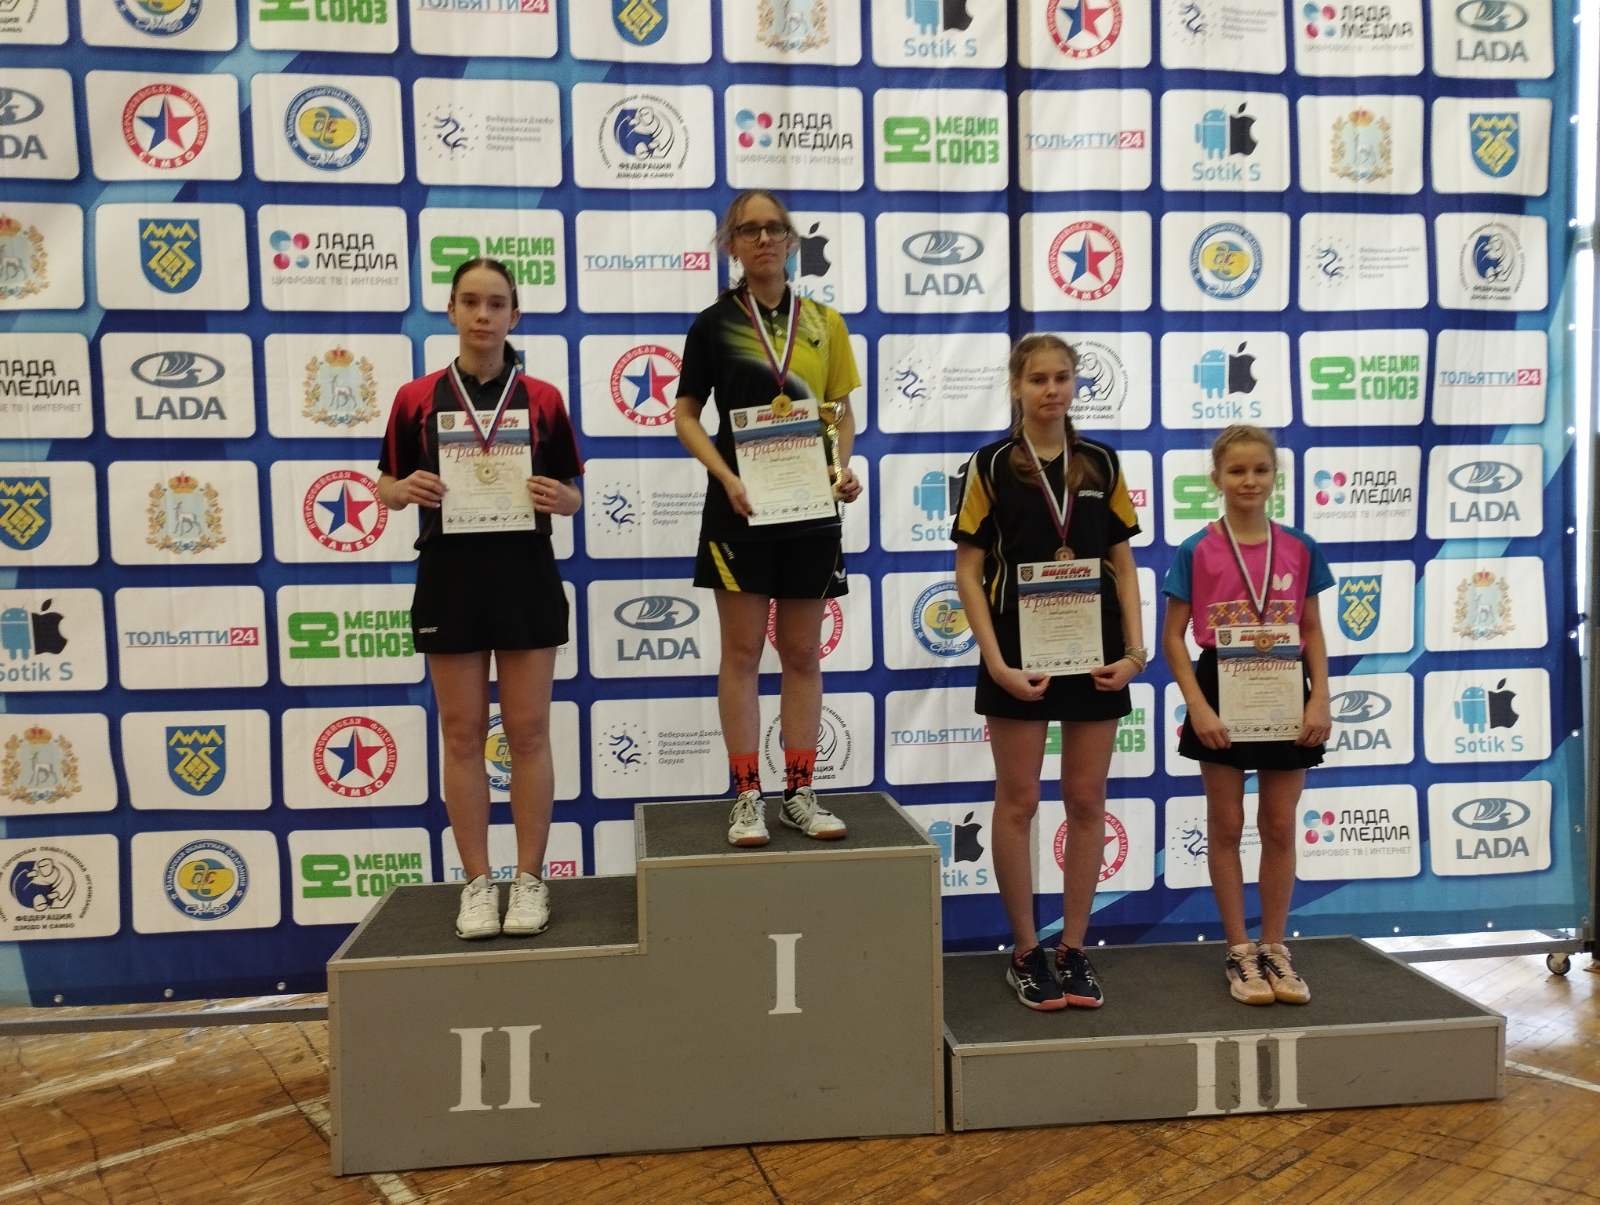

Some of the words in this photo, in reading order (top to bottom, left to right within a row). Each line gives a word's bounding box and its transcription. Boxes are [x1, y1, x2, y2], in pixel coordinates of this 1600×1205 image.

[315, 0, 388, 25] СОЮЗ
[1340, 5, 1391, 21] ЛАДА
[1340, 23, 1413, 40] МЕДИА
[904, 38, 957, 58] Sotik
[964, 38, 978, 58] S
[1456, 39, 1530, 63] LADA
[777, 112, 832, 130] ЛАДА
[935, 116, 999, 136] МЕДИА
[0, 135, 48, 161] DA
[777, 132, 853, 151] МЕДИА
[138, 149, 196, 169] САМБО
[935, 139, 999, 165] СОЮЗ
[1192, 162, 1242, 182] Sotik
[1249, 162, 1262, 182] S
[315, 232, 375, 251] ЛАДА
[486, 236, 555, 256] МЕДИА
[316, 253, 399, 272] МЕДИА
[504, 259, 556, 286] ОЮЗ
[905, 272, 985, 296] LADA
[0, 359, 56, 377] ЛАДА
[1360, 355, 1420, 374] МЕДИА
[0, 379, 81, 399] МЕДИА
[1361, 376, 1419, 400] СОЮЗ
[135, 397, 227, 421] LADA
[1192, 401, 1243, 419] Sotik
[1250, 401, 1262, 418] S
[1352, 470, 1397, 487] ЛАДА
[1350, 487, 1412, 505] МЕДИА
[1450, 501, 1521, 523] LADA
[911, 523, 951, 542] Soti
[318, 534, 376, 552] САМБО
[345, 633, 415, 658] СОЮЗ
[617, 637, 701, 662] LADA
[60, 662, 74, 681] S
[1455, 736, 1504, 754] Sotik
[1511, 735, 1524, 752] S
[327, 779, 385, 797] САМБО
[1339, 808, 1390, 825] ЛАДА
[1340, 825, 1410, 843] МЕДИА
[1456, 836, 1530, 860] LADA
[354, 853, 422, 872] МЕДИА
[942, 870, 968, 888] tik
[975, 868, 988, 886] S
[449, 1024, 541, 1112] II
[1187, 1031, 1308, 1116] III
